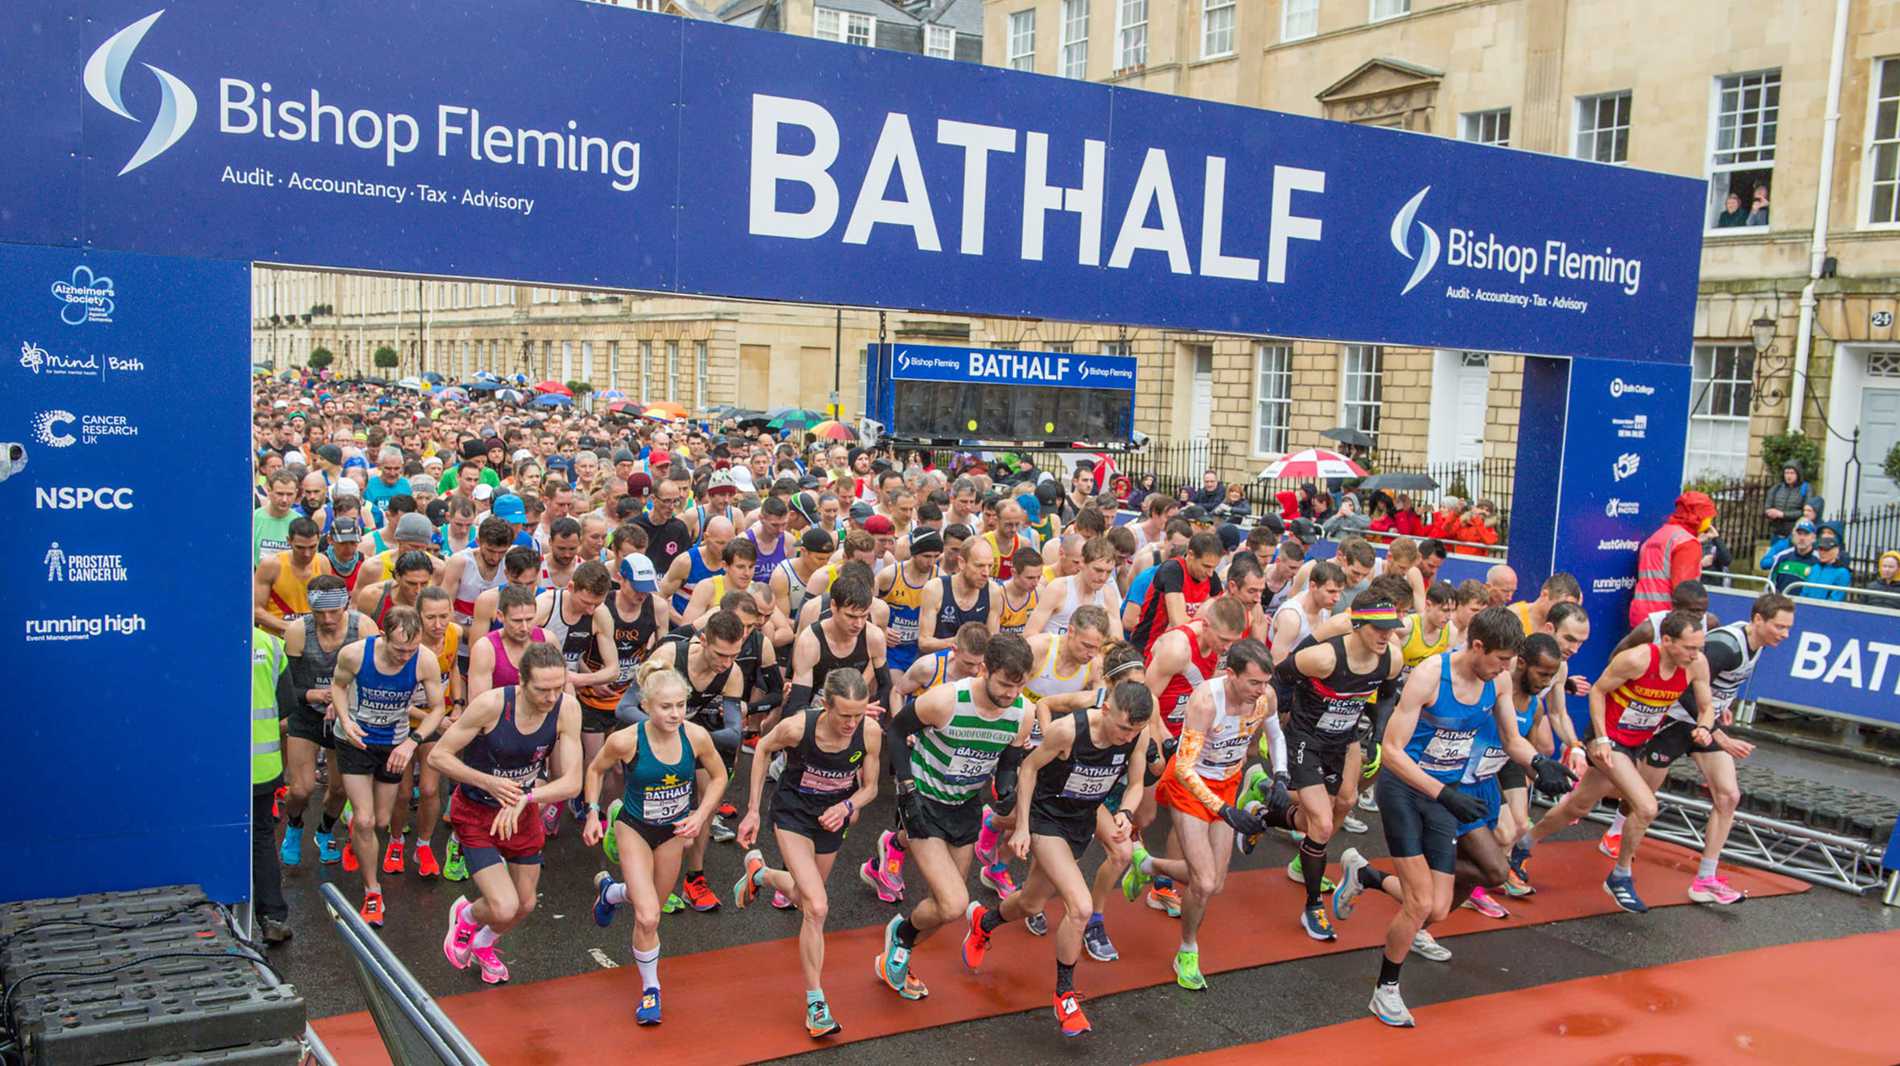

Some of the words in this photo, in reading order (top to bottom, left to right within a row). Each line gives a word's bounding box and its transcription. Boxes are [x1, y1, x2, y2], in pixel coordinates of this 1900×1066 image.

[218, 77, 420, 166] Bishop
[436, 104, 641, 192] Fleming
[221, 166, 274, 188] Audit
[288, 172, 406, 203] Accountancy
[417, 184, 448, 203] Tax
[461, 188, 534, 215] Advisory
[749, 93, 1325, 284] BATHALF
[1447, 228, 1538, 284] Bishop
[1544, 240, 1642, 296] Fleming
[65, 294, 105, 307] Society
[1446, 286, 1470, 299] Audit
[1475, 288, 1529, 308] Accountancy
[1532, 294, 1548, 306] Tax
[1552, 296, 1588, 313] Advisory
[1872, 313, 1891, 326] 24
[46, 354, 100, 369] mind
[108, 356, 144, 371] Bath
[911, 357, 934, 368] Bishop
[934, 358, 960, 370] Fleming
[968, 352, 1070, 381] BATHALF
[1089, 367, 1109, 378] Bishop
[1110, 368, 1133, 379] Fleming
[82, 415, 127, 425] CANCER
[82, 425, 138, 436] RESEARCH
[82, 436, 97, 445] UK
[35, 487, 134, 510] NSPCC
[1598, 539, 1640, 551] JustGiving
[69, 555, 122, 568] PROSTATE
[69, 568, 112, 581] CANCER
[113, 568, 128, 581] UK
[26, 615, 102, 635] running
[104, 613, 146, 635] high
[1790, 631, 1900, 696] BAT
[948, 727, 993, 739] WOODFORD
[1225, 749, 1234, 760] 5
[960, 763, 982, 776] 349
[1074, 765, 1121, 776] BATHALF
[645, 782, 692, 800] BATHALF
[1079, 782, 1103, 793] 350
[661, 804, 678, 816] 37
